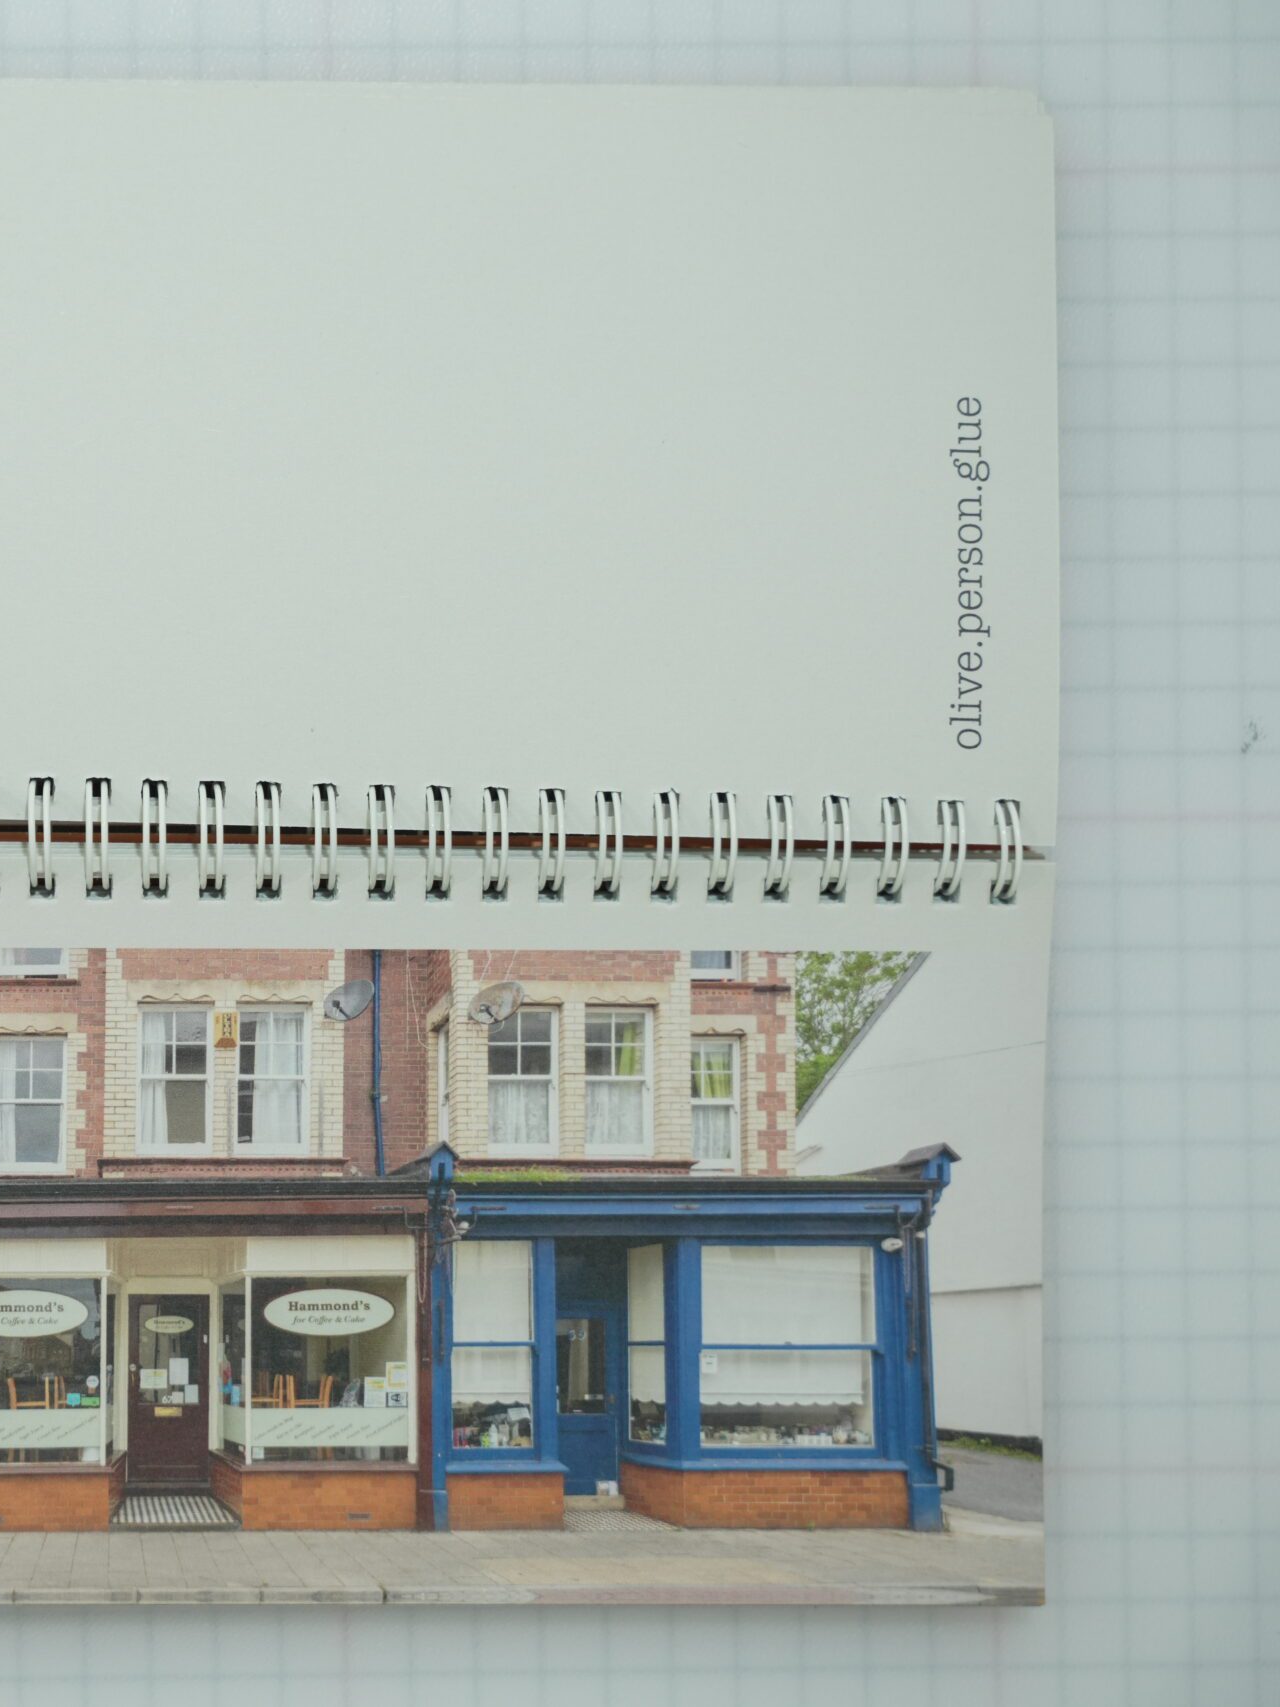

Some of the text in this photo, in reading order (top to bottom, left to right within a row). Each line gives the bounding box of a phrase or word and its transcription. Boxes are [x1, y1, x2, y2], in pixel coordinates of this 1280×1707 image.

[949, 396, 990, 750] olive.person.glue
[288, 1300, 371, 1312] Hammond's
[0, 1317, 26, 1327] Coffee
[27, 1317, 35, 1325] &
[36, 1317, 59, 1325] Cake
[292, 1315, 366, 1326] for Coffee & Cake
